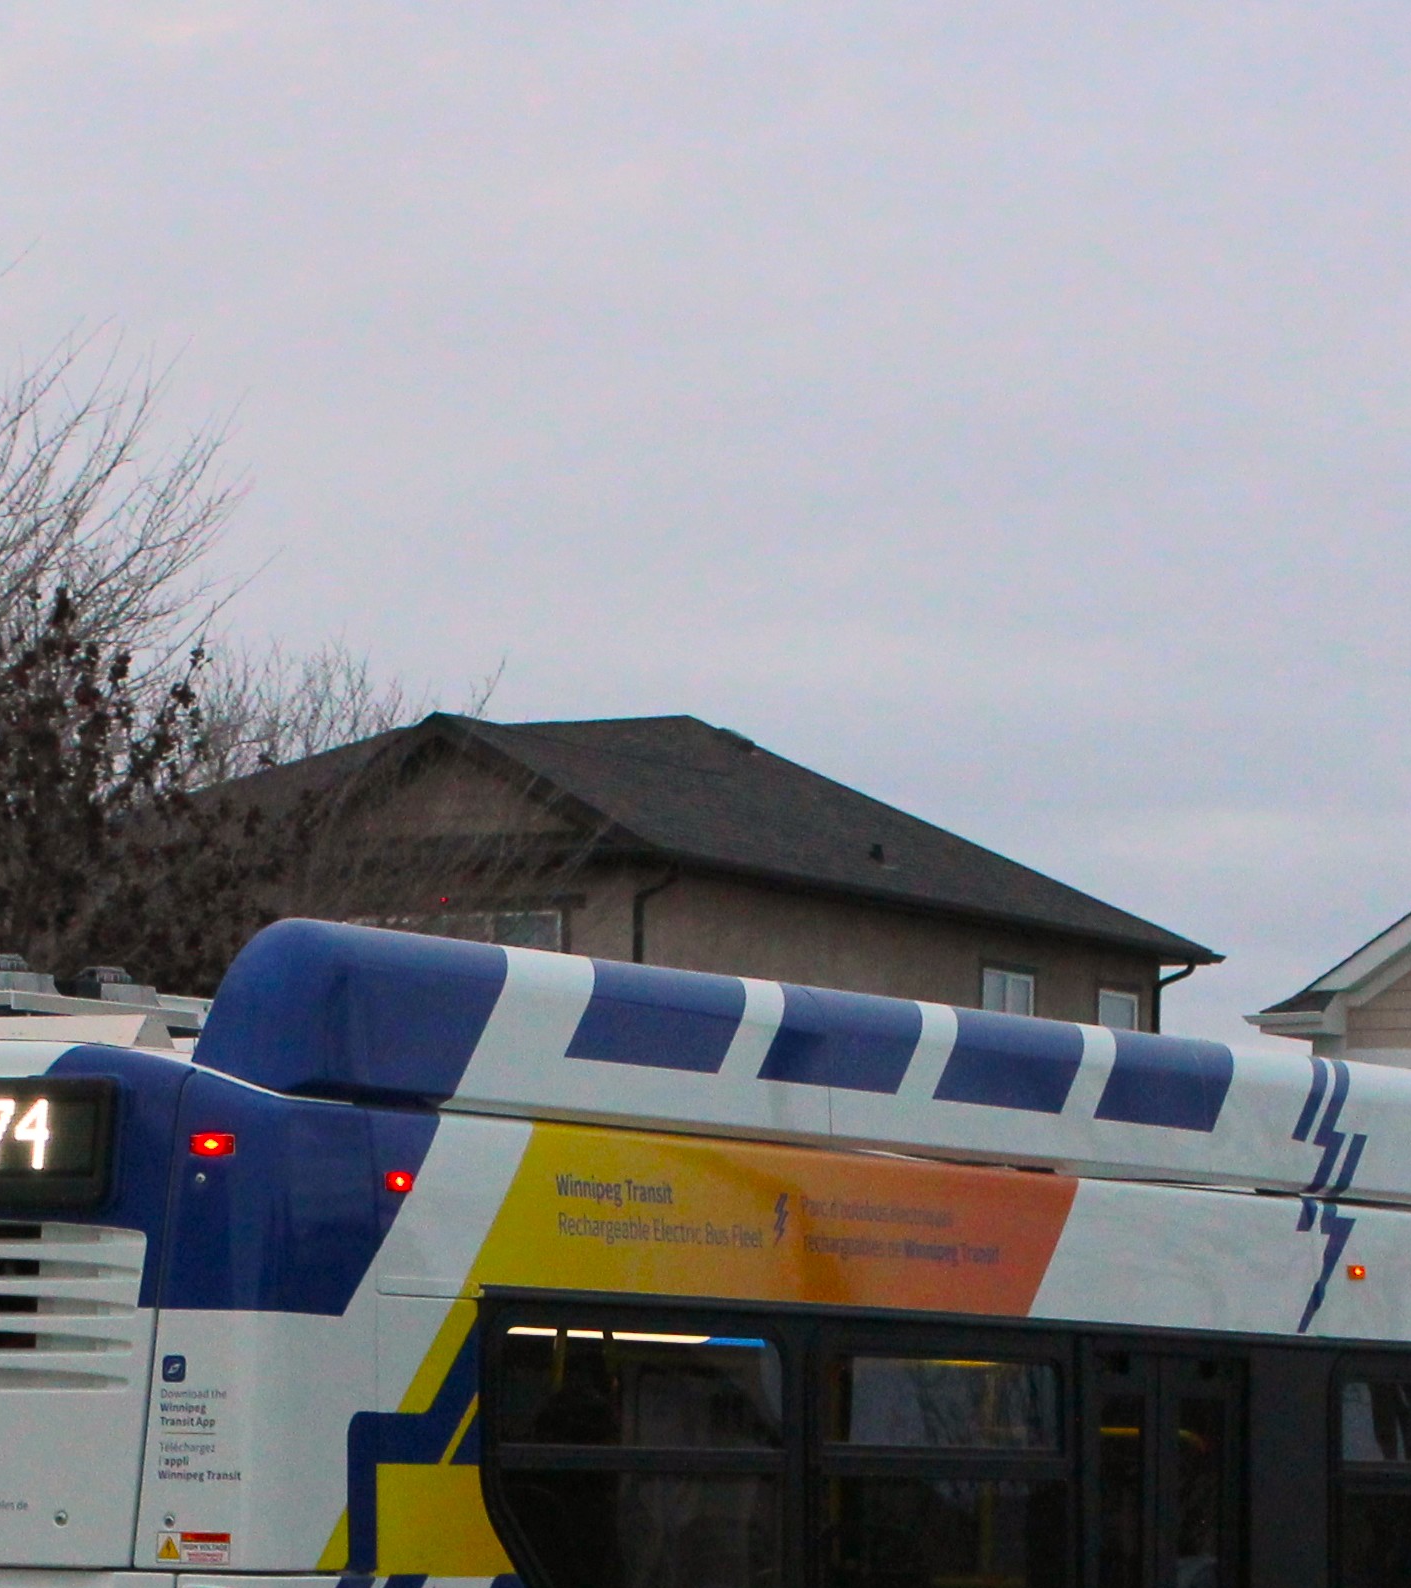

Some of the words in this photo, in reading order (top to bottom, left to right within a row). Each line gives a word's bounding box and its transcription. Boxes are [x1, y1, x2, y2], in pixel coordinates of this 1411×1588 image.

[555, 1173, 623, 1207] Winnipeg
[625, 1180, 673, 1204] Transit
[558, 1212, 651, 1245] Rechargeable
[653, 1218, 701, 1244] Electric
[705, 1221, 728, 1246] Bus
[732, 1224, 763, 1248] Fleet
[160, 1388, 209, 1399] Download
[211, 1389, 227, 1399] the
[160, 1402, 207, 1415] Winnipeg
[160, 1416, 194, 1426] Transit
[196, 1417, 216, 1428] App
[158, 1470, 205, 1483] Winnipeg
[207, 1471, 242, 1481] Transit
[16, 1500, 29, 1511] de
